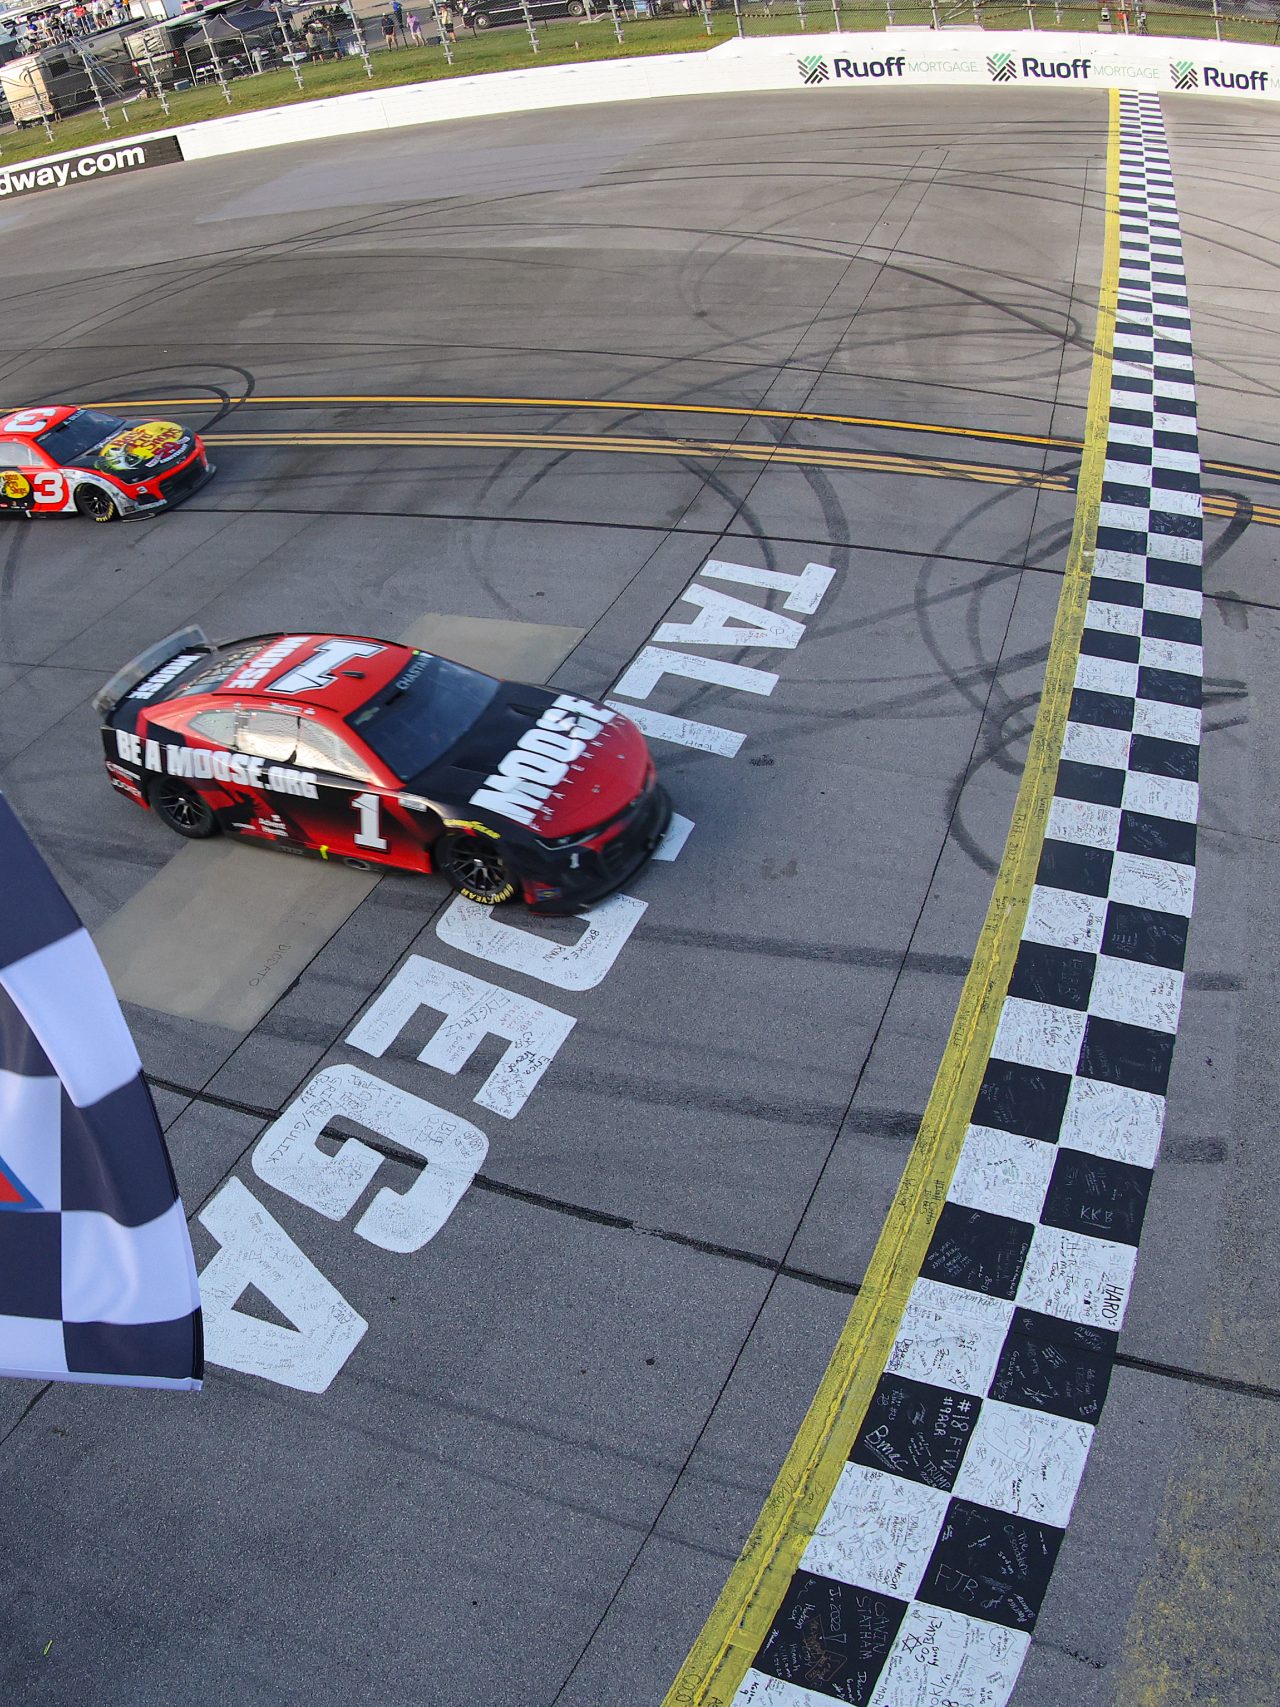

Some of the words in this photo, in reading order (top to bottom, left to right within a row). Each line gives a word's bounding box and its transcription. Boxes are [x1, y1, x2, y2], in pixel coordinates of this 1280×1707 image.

[834, 55, 905, 78] Ruoff
[907, 60, 978, 73] MORTGAGE
[1022, 57, 1092, 80] Ruoff
[1093, 65, 1160, 80] MORTGAGE
[1203, 65, 1269, 91] Ruoff
[33, 472, 64, 504] 3
[129, 654, 201, 700] MOOSE
[224, 636, 312, 689] MOOSE
[265, 639, 388, 695] 1
[115, 729, 143, 766] BE
[144, 738, 163, 773] A
[166, 744, 320, 800] MOOSE.ORG
[469, 694, 618, 826] MOOSE
[351, 793, 387, 850] 1
[569, 853, 580, 869] 1
[950, 1399, 972, 1432] #18
[923, 1459, 952, 1489] TRUMP
[855, 1595, 873, 1660] STATHAM
[874, 1601, 891, 1655] GAVIN
